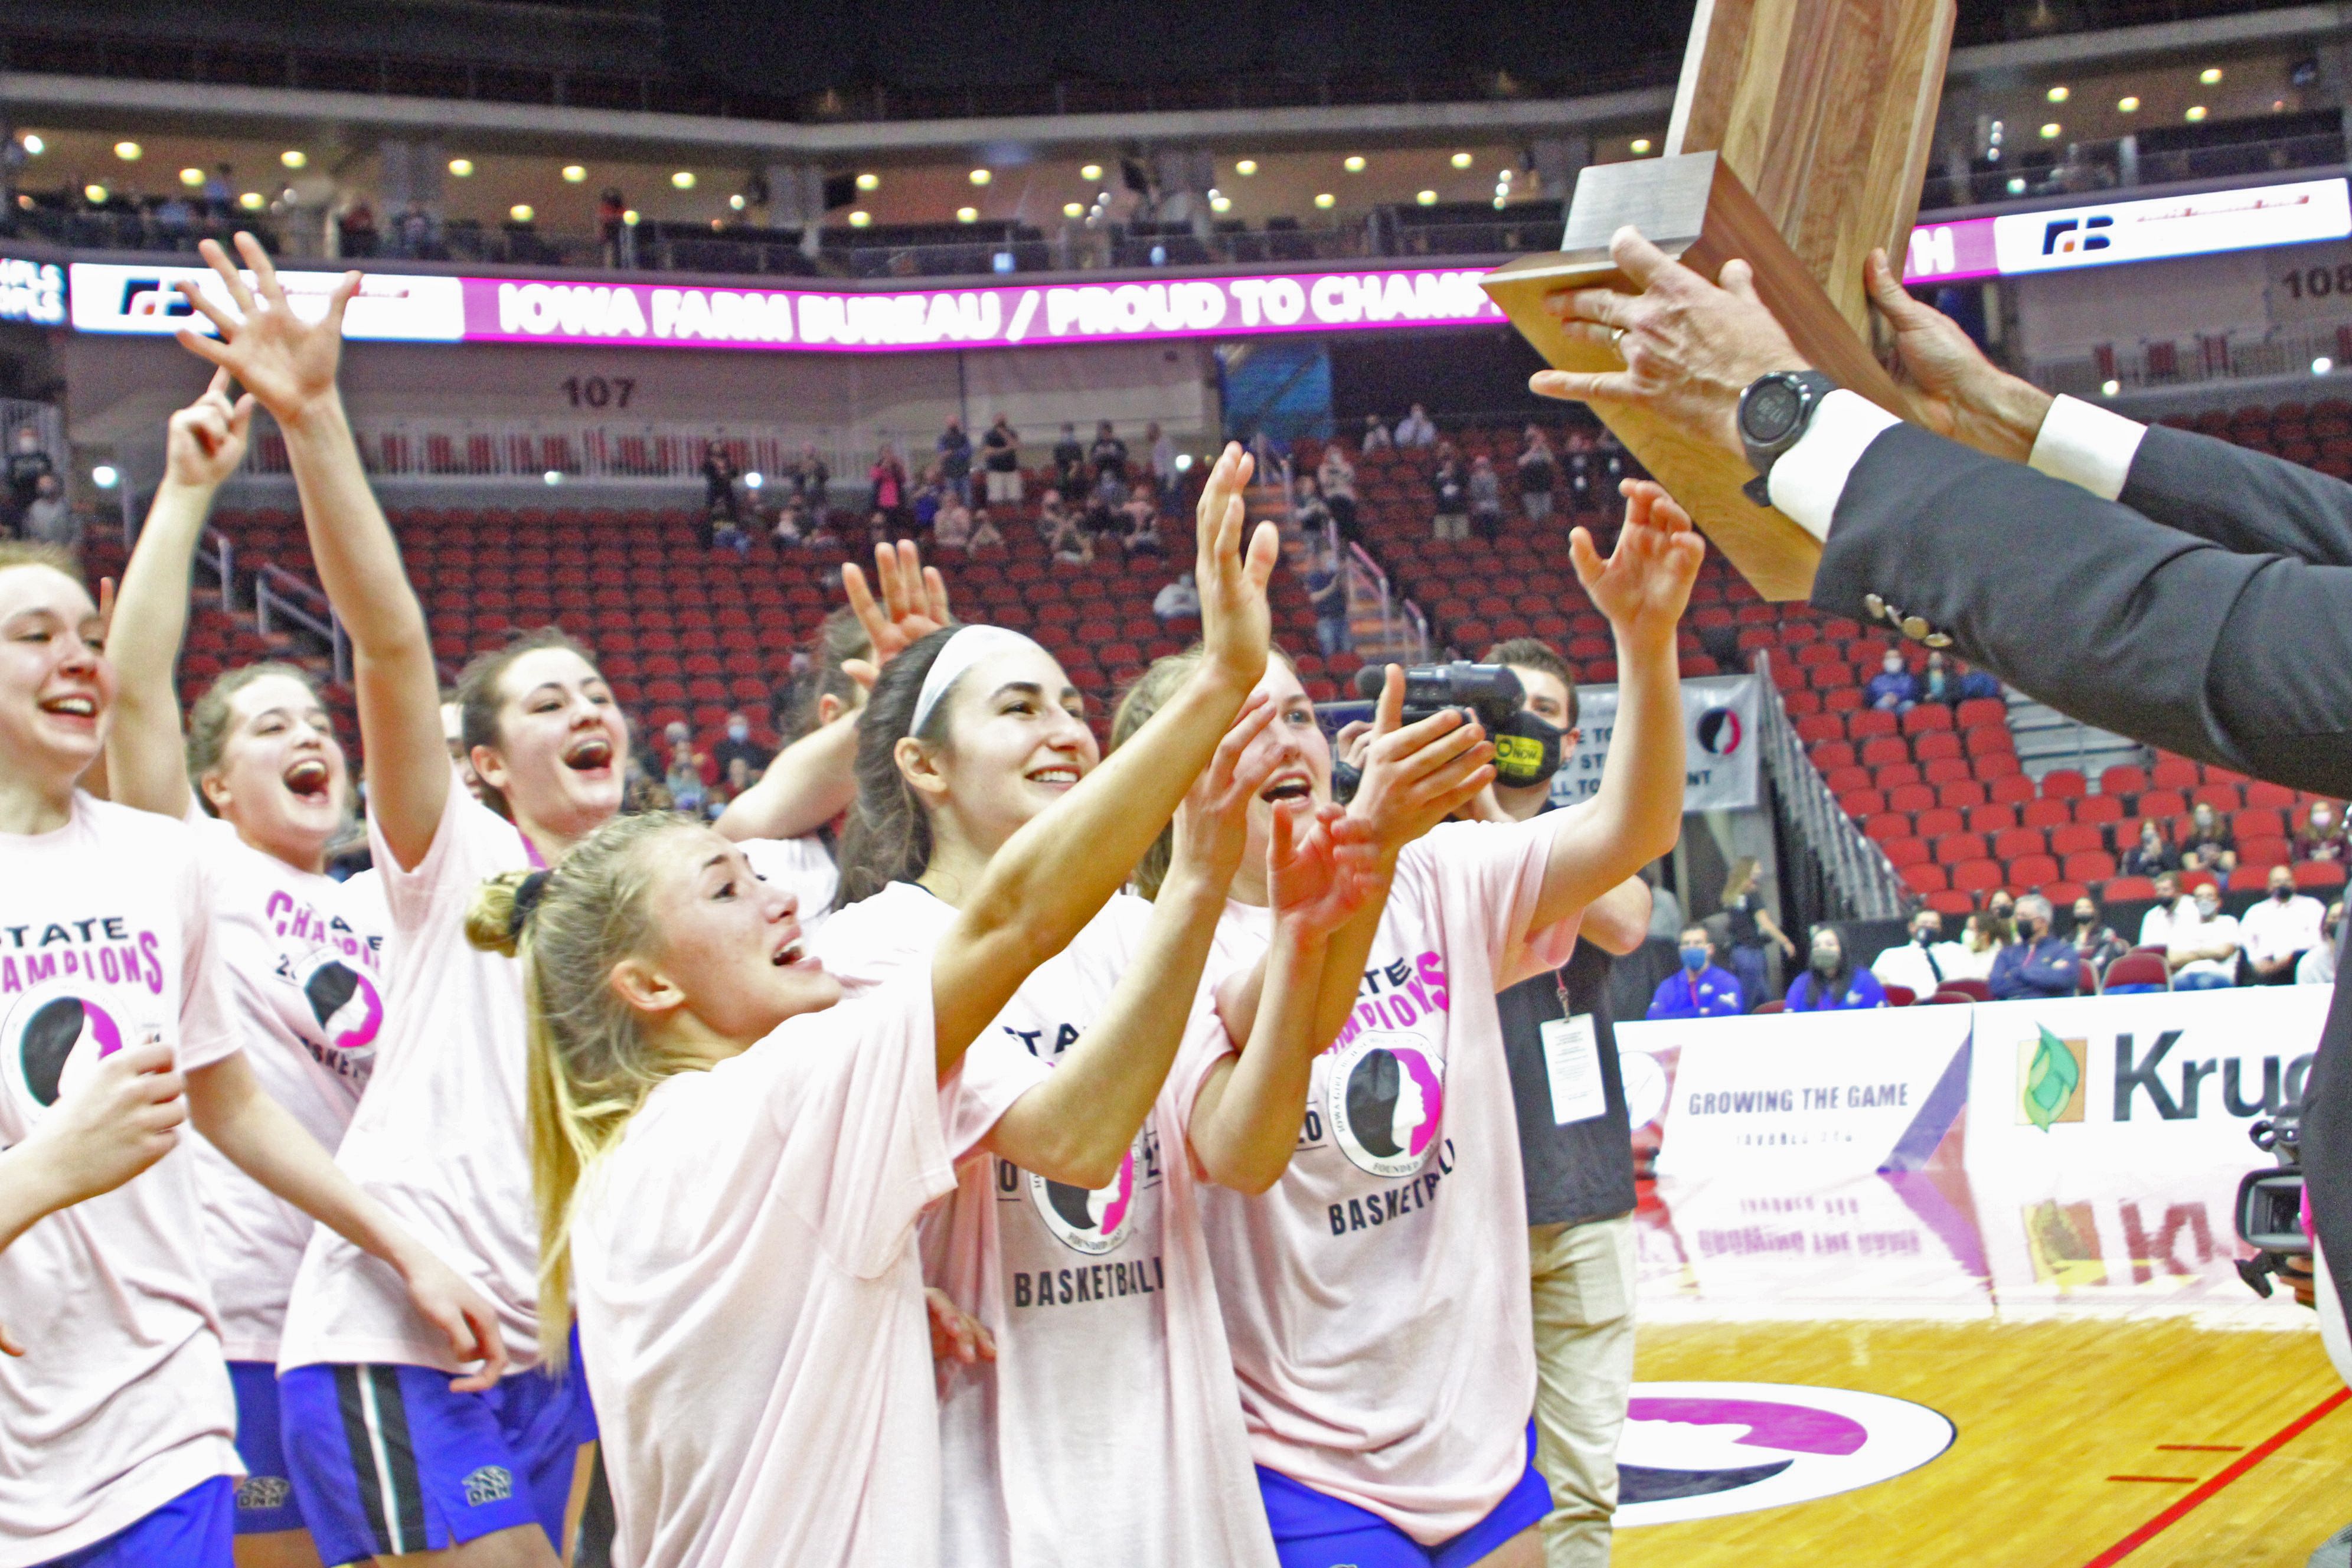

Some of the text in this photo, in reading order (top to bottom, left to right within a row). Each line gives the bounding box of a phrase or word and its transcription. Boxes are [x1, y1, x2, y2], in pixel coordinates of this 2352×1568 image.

[498, 283, 646, 337] IOWA
[651, 289, 793, 342] FARM
[798, 292, 1001, 344] BUREAU
[1047, 282, 1226, 335] PROUD
[1230, 278, 1305, 326] TO
[1311, 272, 1502, 323] CHAMP
[562, 376, 635, 408] 107
[0, 916, 129, 948] TATE
[2, 930, 163, 995] AMPIONS
[1689, 1083, 1908, 1115] GROWING THE GAME
[1298, 1110, 1322, 1141] 0
